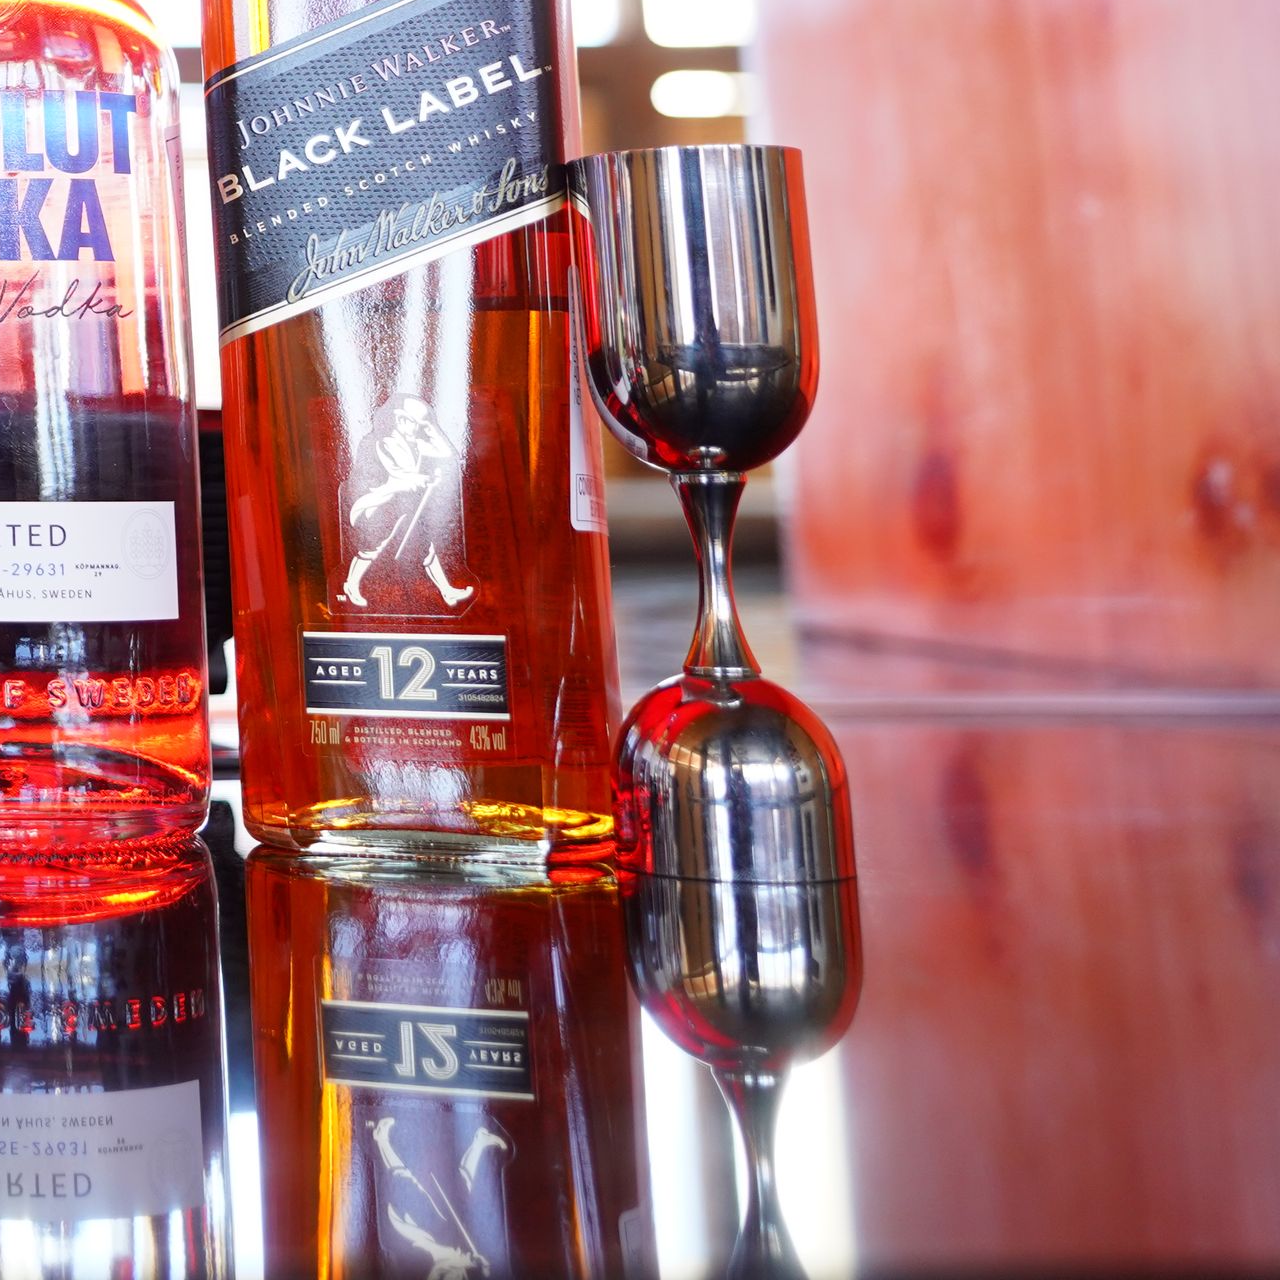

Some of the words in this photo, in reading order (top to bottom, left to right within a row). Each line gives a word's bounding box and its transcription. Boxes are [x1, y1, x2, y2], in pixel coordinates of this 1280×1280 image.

[236, 74, 368, 149] JOHNNIE
[216, 119, 371, 205] BLACK
[229, 196, 329, 245] BLENDED
[343, 154, 433, 197] SCOTCH
[448, 111, 538, 154] WHISKY
[286, 229, 370, 304] John
[371, 191, 468, 258] Walker
[491, 157, 550, 214] Sons
[41, 589, 93, 599] SWEDEN
[46, 673, 191, 708] SWEDEN
[315, 665, 363, 677] AGED
[369, 646, 438, 701] 12
[446, 668, 499, 680] YEARS
[309, 720, 326, 745] 750
[329, 720, 340, 745] ml
[353, 736, 396, 744] BOTTLED
[399, 737, 409, 745] IN
[412, 738, 463, 747] SCOTLAND
[408, 728, 452, 737] BLENDED
[469, 726, 490, 751] 43%
[491, 726, 506, 751] vol
